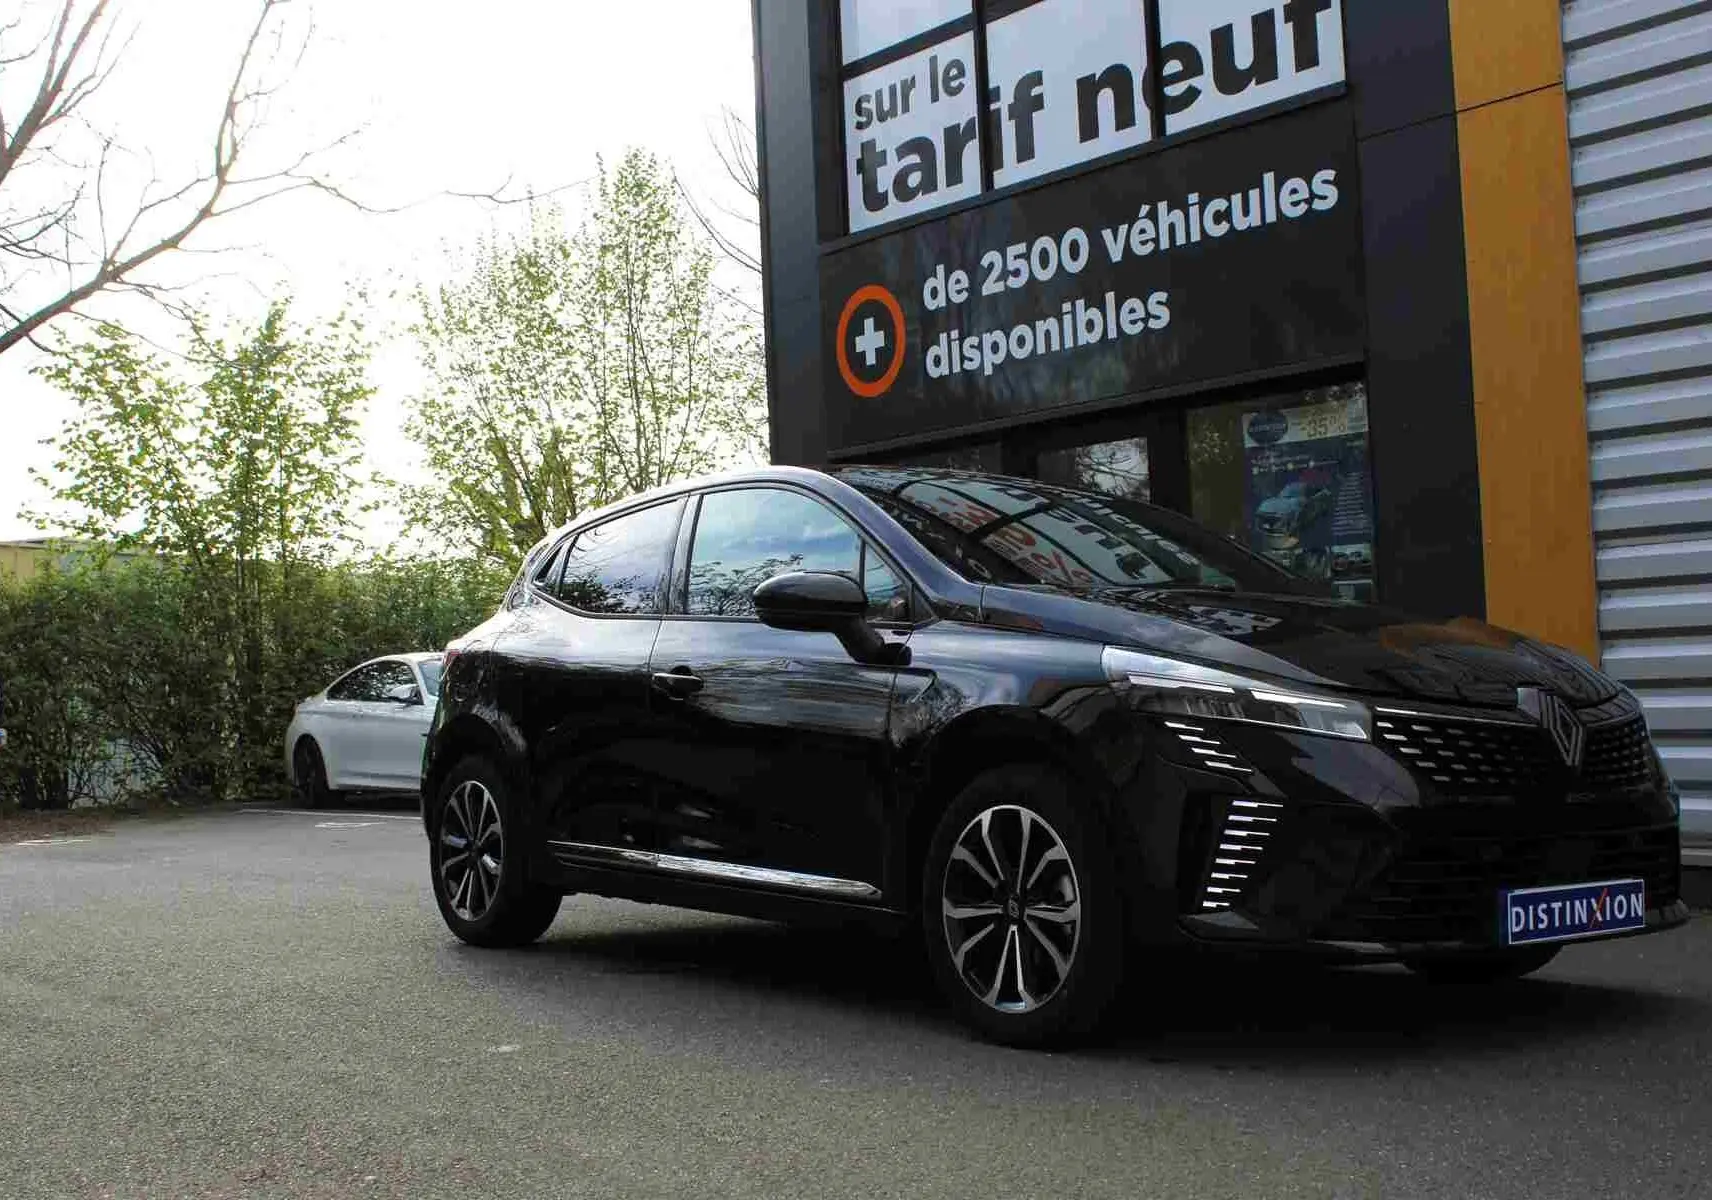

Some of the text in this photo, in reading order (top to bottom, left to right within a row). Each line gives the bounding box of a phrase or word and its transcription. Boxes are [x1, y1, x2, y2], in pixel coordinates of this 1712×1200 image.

[854, 55, 966, 130] sur le
[856, 0, 1332, 212] tarif neuf
[923, 168, 1339, 311] de 2500 véhicules
[925, 289, 1171, 379] disponibles
[1511, 888, 1643, 933] DISTINXION
